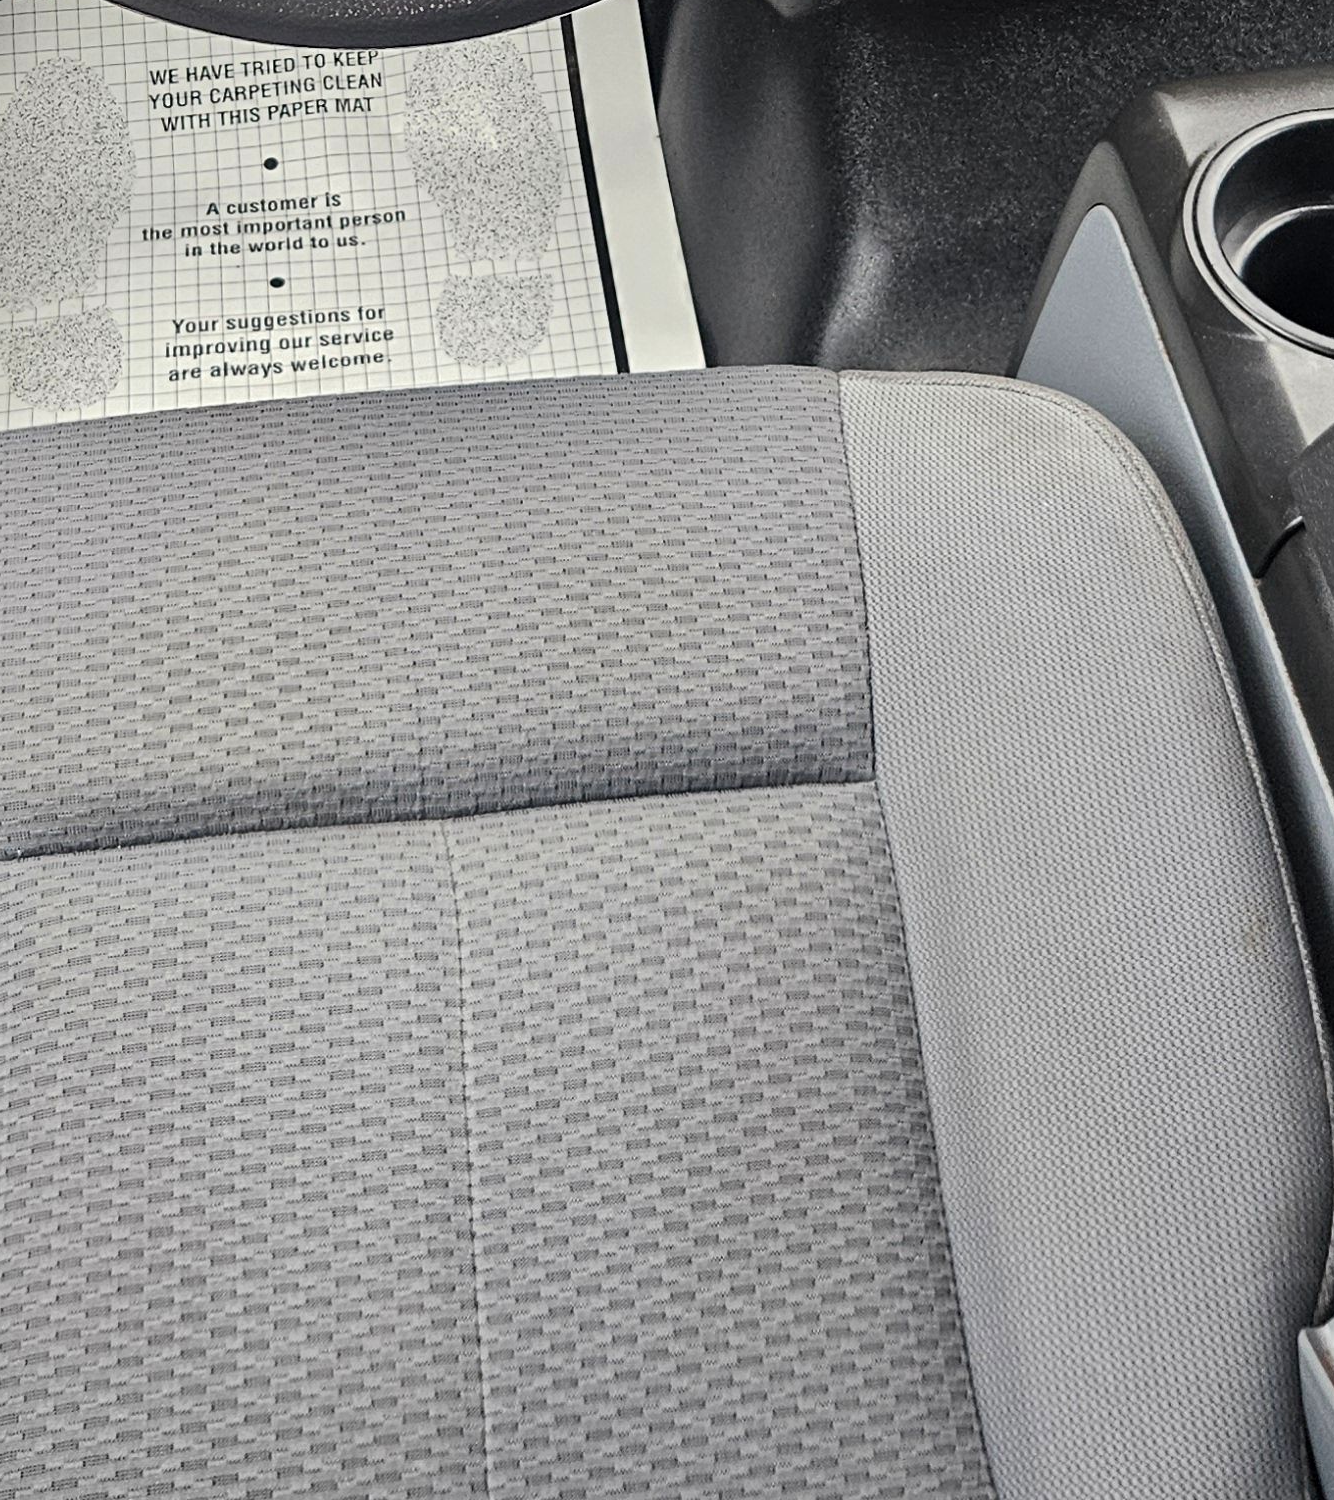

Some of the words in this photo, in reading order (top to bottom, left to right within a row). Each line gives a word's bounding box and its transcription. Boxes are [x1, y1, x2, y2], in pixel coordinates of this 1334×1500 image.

[149, 68, 179, 86] WE
[186, 63, 235, 83] HAVE
[240, 57, 296, 77] TRIED
[302, 53, 326, 70] TO
[333, 50, 379, 67] KEEP
[148, 90, 202, 110] YOUR
[209, 77, 315, 104] CARPETING
[322, 72, 383, 90] CLEAN
[161, 113, 211, 132] WITH
[217, 107, 261, 127] THIS
[267, 99, 328, 121] PAPER
[335, 96, 375, 113] MAT
[205, 202, 219, 216] A
[226, 195, 318, 215] customer
[325, 192, 342, 207] is
[142, 227, 173, 241] the
[180, 222, 229, 238] most
[236, 214, 334, 236] important
[339, 209, 406, 230] person
[184, 243, 203, 257] in
[210, 241, 241, 256] the
[248, 237, 303, 252] world
[310, 237, 329, 249] to
[336, 234, 366, 248] us.
[172, 318, 219, 334] Your
[226, 307, 351, 332] suggestions
[358, 306, 386, 321] for
[165, 337, 271, 359] improving
[279, 335, 312, 350] our
[319, 328, 394, 347] service
[168, 367, 202, 382] are
[210, 360, 283, 378] always
[291, 351, 392, 373] welcome.
